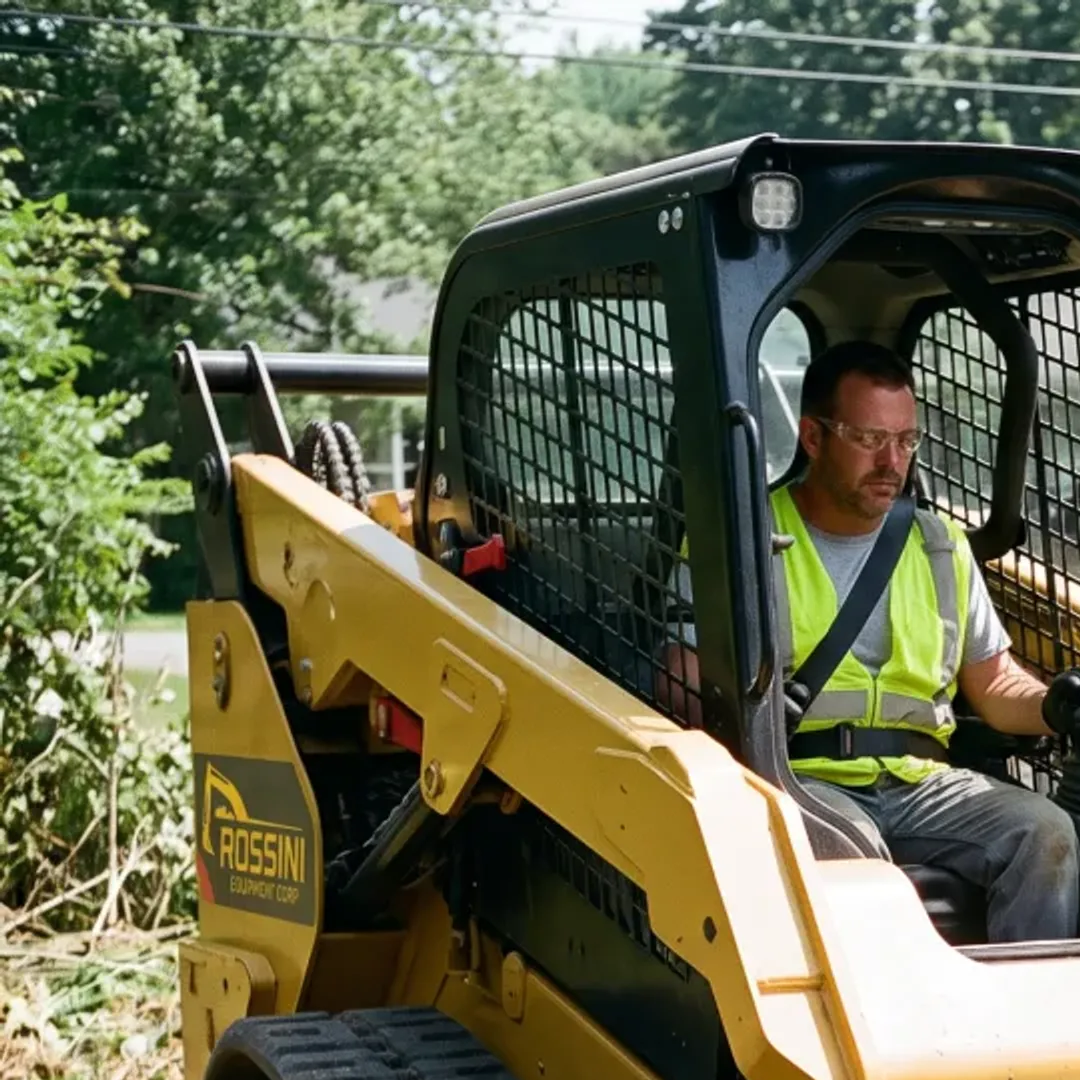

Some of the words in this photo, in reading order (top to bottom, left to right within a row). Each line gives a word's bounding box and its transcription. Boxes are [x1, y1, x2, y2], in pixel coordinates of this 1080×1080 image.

[220, 827, 305, 883] ROSSINI
[230, 875, 275, 900] EQUIPMENT
[277, 885, 299, 904] CORP
